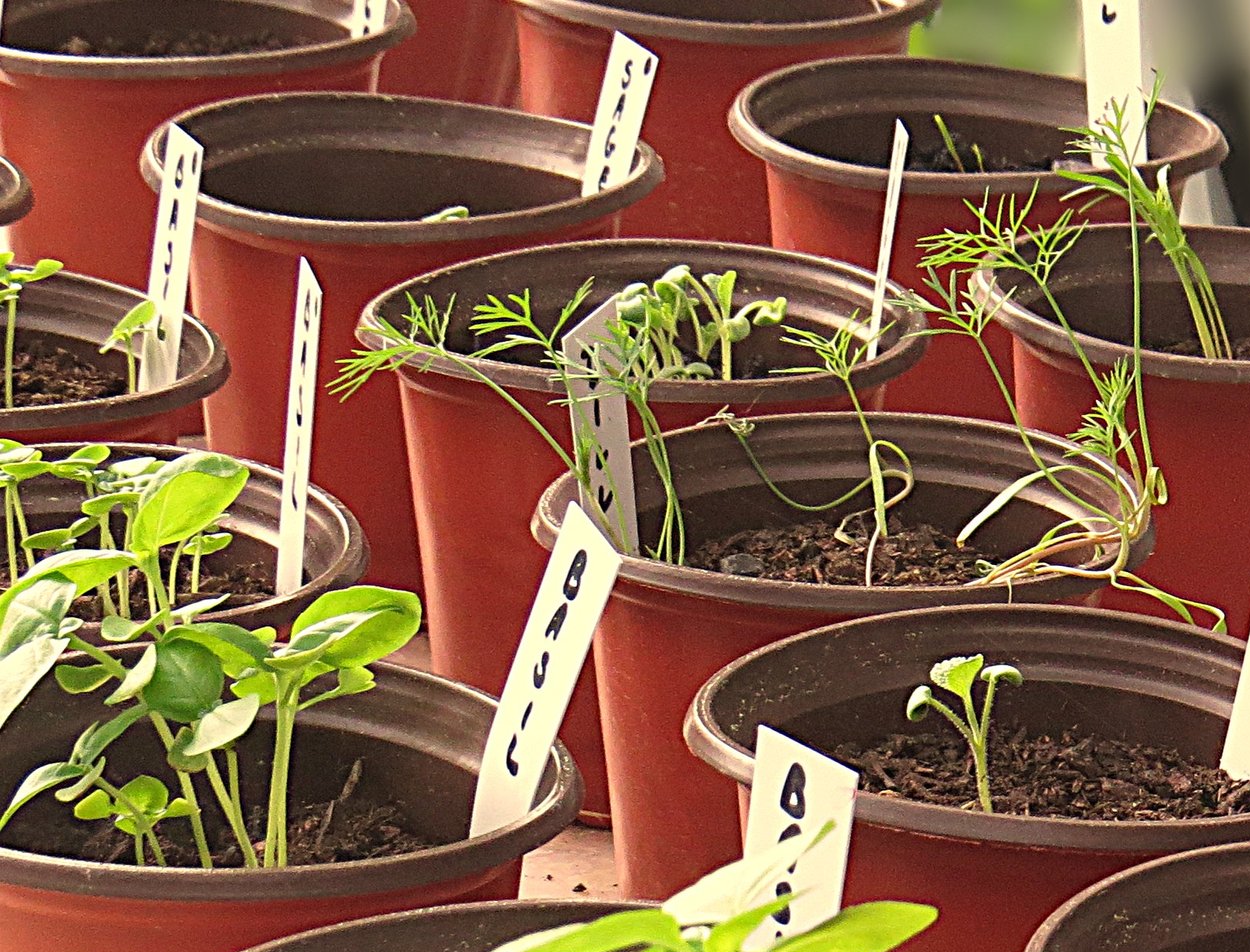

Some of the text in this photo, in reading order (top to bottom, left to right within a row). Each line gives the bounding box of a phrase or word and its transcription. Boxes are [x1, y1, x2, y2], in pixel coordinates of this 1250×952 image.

[598, 59, 633, 193] SAGE
[156, 153, 185, 342] BASIL
[506, 549, 587, 777] BASIL
